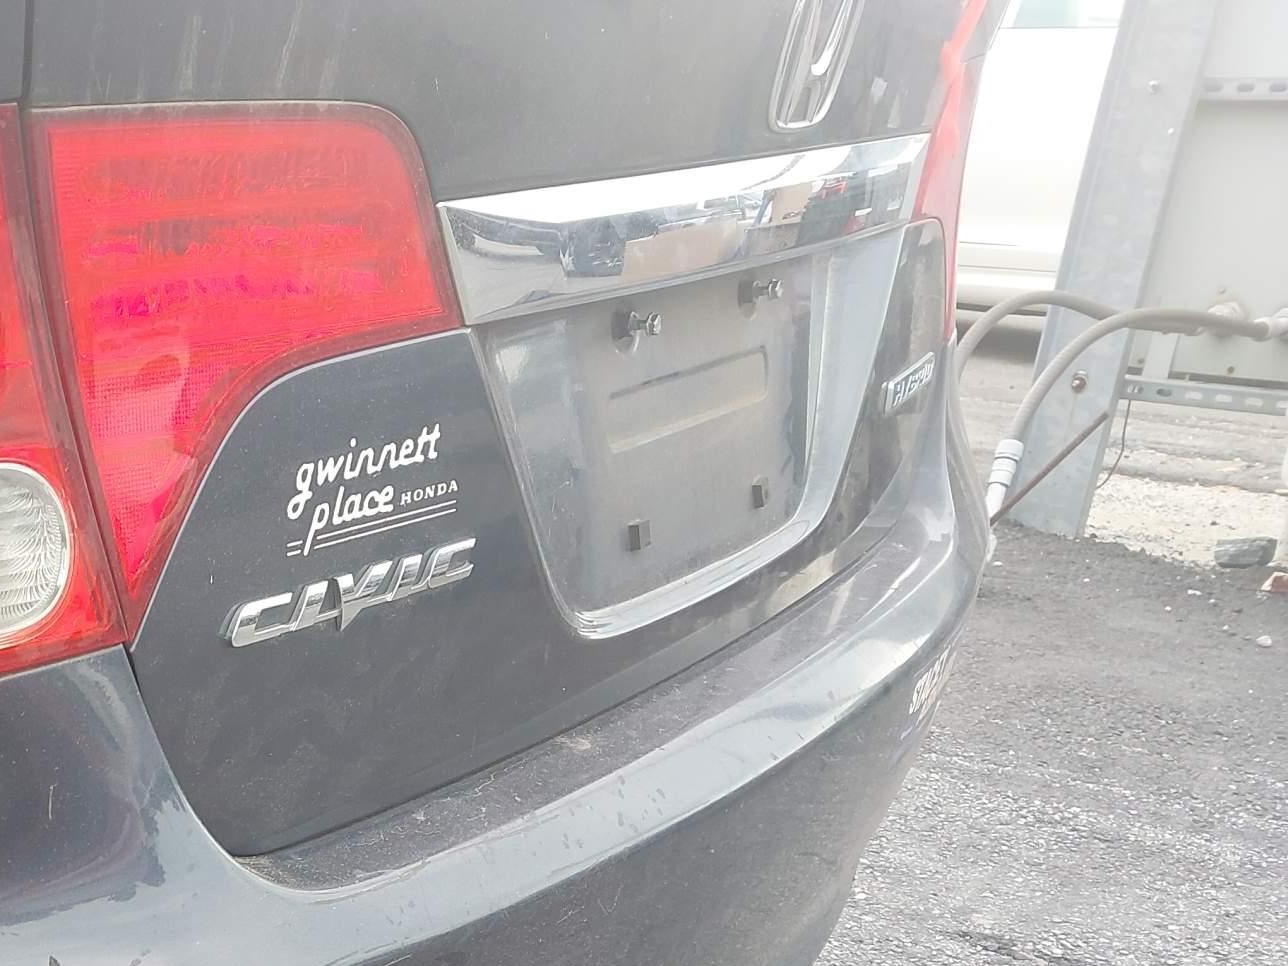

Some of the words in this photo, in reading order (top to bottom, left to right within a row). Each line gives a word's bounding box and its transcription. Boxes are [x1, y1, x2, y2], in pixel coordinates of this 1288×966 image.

[286, 423, 441, 520] gwinnett
[303, 485, 394, 556] place
[399, 479, 458, 507] HONDA
